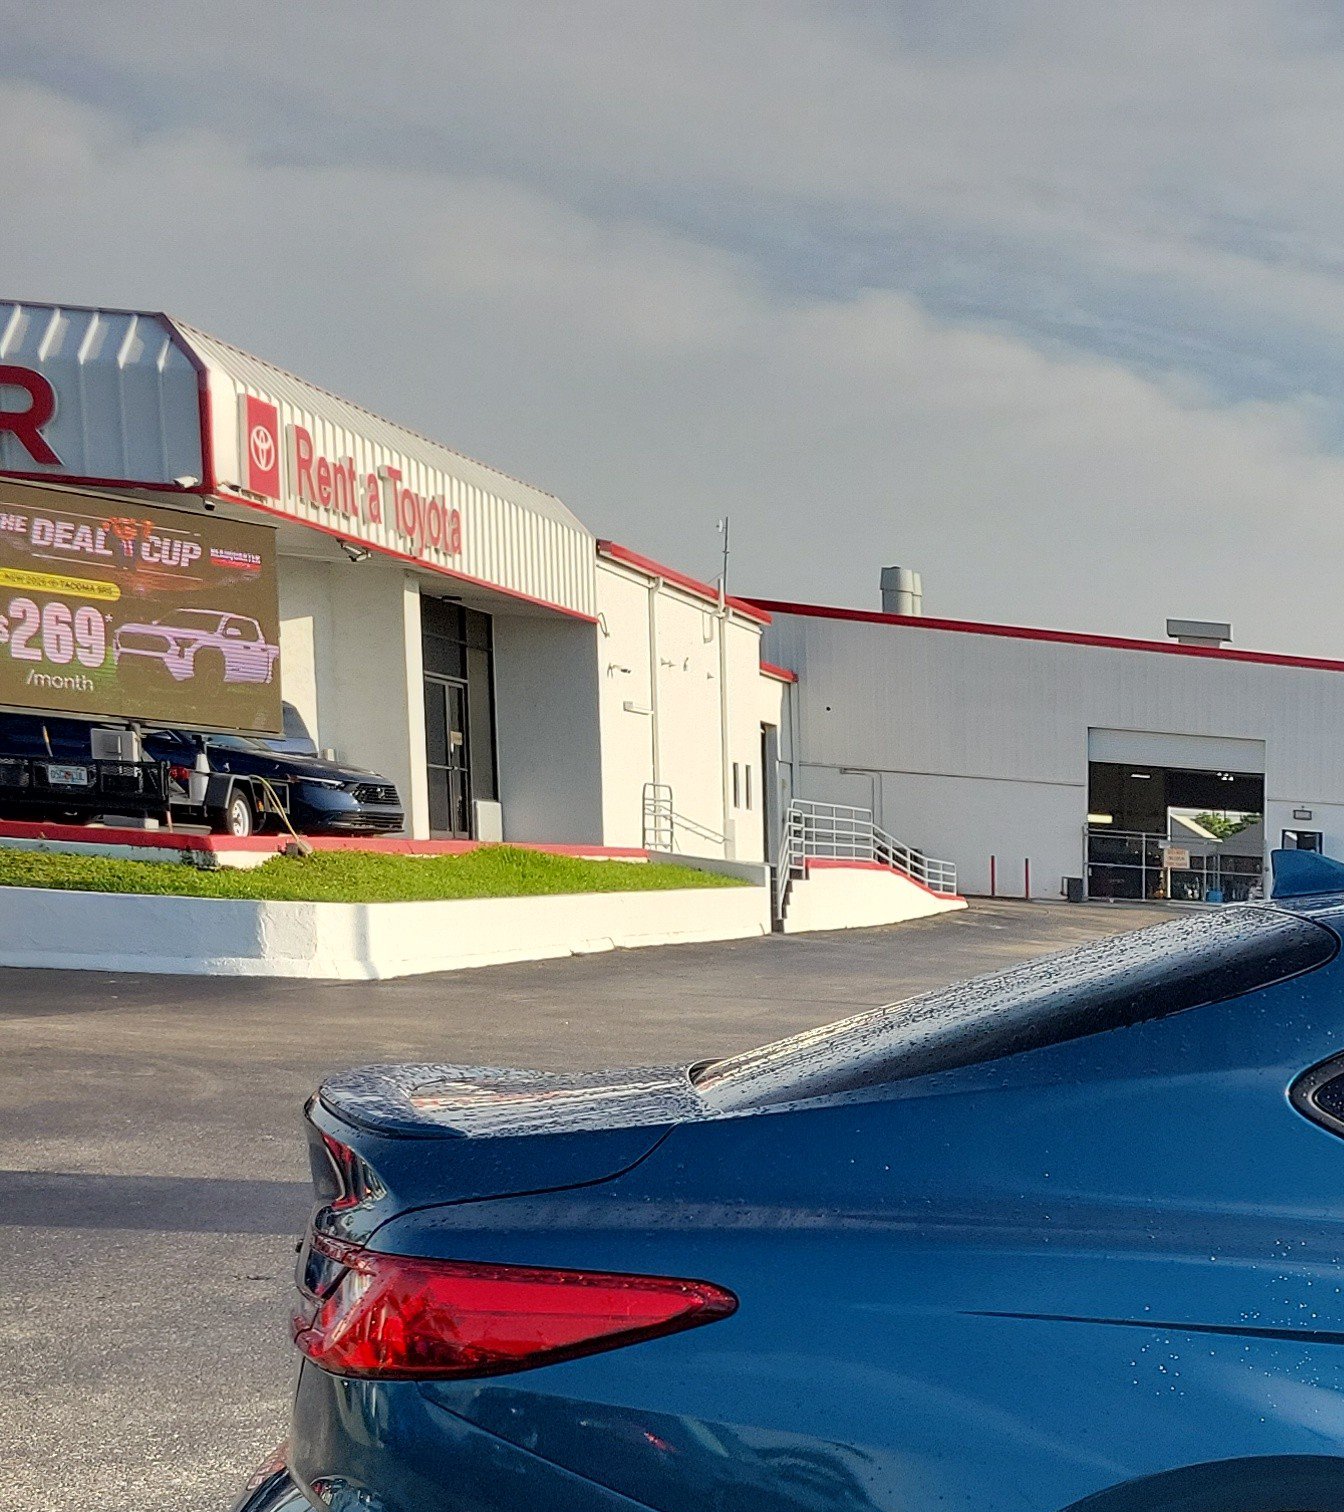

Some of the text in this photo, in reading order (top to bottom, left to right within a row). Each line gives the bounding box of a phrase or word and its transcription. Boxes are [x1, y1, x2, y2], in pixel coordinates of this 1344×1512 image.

[293, 424, 462, 558] Rent a Toyota
[31, 517, 113, 556] DEAL
[141, 535, 202, 567] CUP
[27, 669, 94, 691] /month
